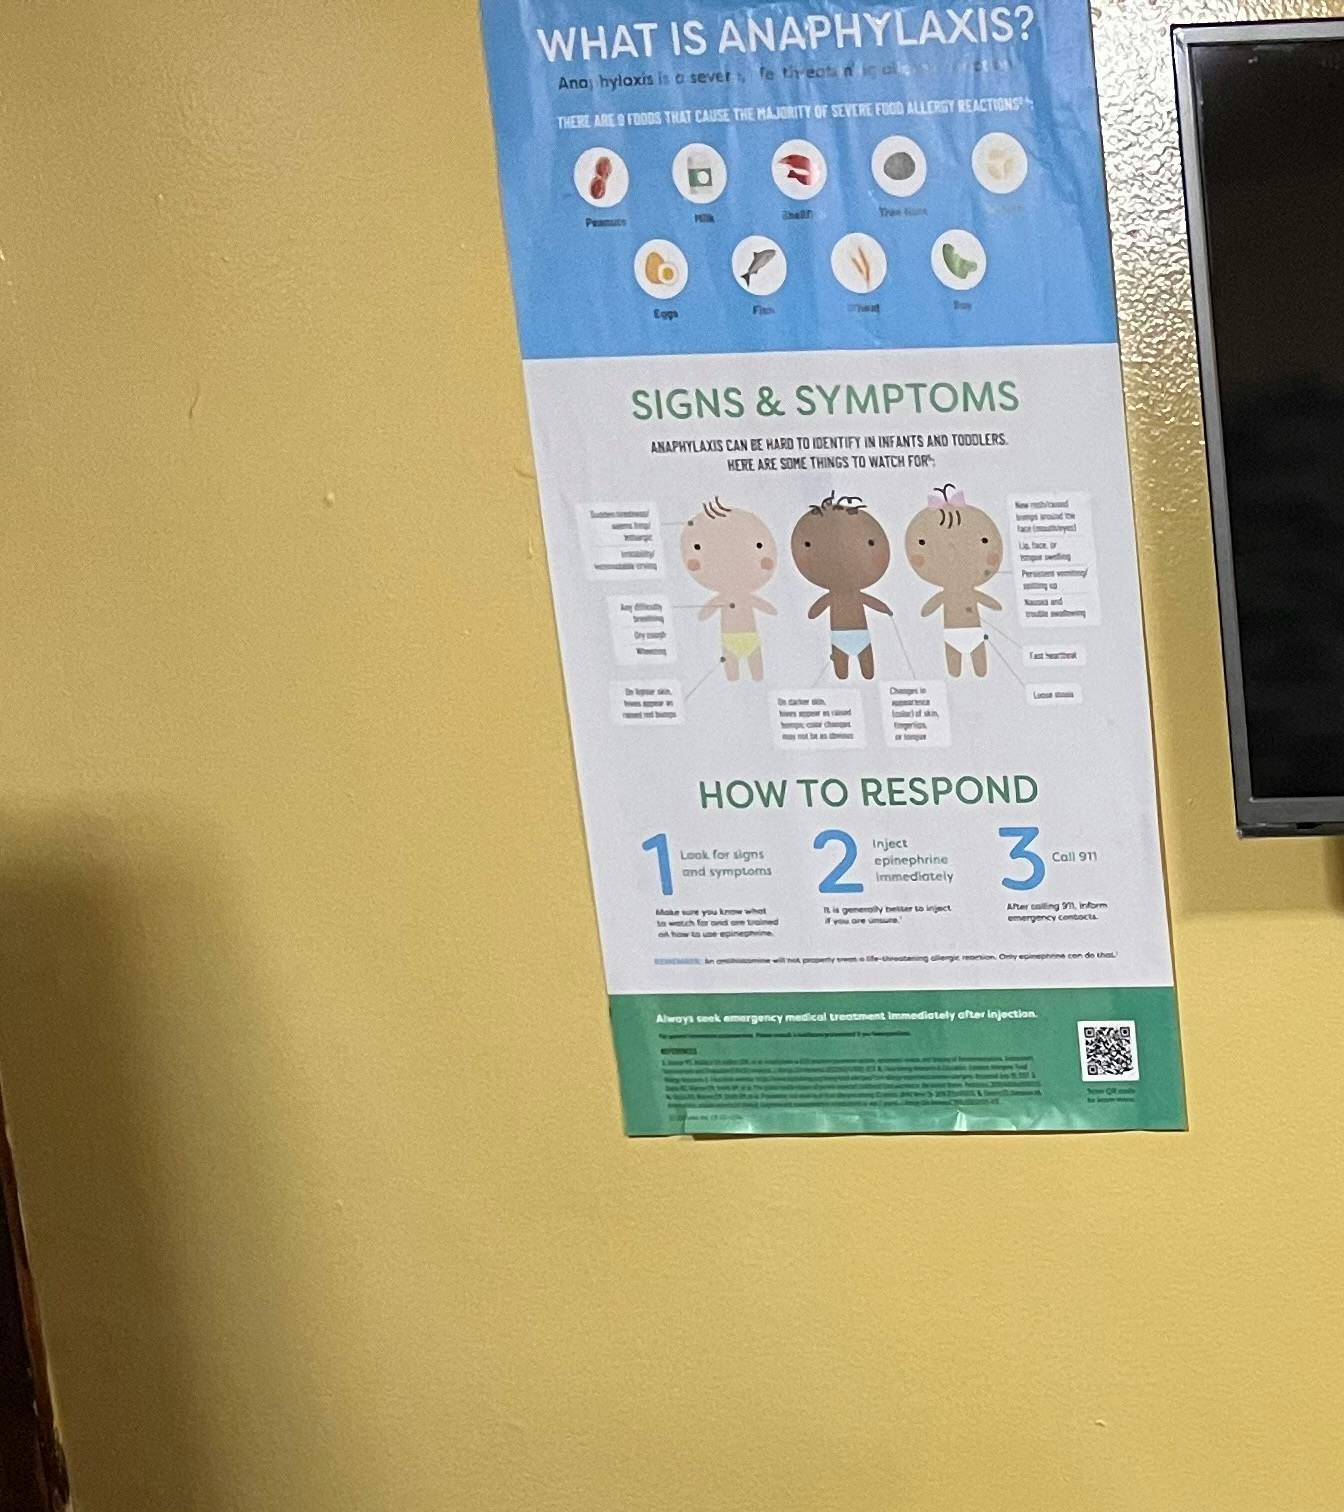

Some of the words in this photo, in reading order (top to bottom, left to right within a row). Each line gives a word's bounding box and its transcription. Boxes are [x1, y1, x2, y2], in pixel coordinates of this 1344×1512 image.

[536, 23, 658, 62] WHAT
[671, 20, 707, 56] IS
[718, 5, 1034, 54] ANAPHYLAXIS?
[558, 115, 591, 129] THERE
[594, 114, 617, 128] ARE
[627, 111, 661, 126] FOODS
[664, 109, 691, 124] THAT
[695, 108, 731, 123] CAUSE
[733, 107, 755, 122] THE
[757, 104, 812, 121] MAJORITY
[815, 104, 828, 119] OF
[831, 102, 874, 118] SEVERE
[875, 101, 904, 116] FOOD
[906, 99, 954, 115] ALLERGY
[653, 307, 679, 320] Eggs
[632, 386, 745, 420] SIGNS
[756, 385, 786, 417] &
[795, 380, 1020, 416] SYMPTOMS
[651, 439, 723, 454] ANAPHYLAXIS
[726, 438, 748, 452] CAN
[750, 438, 764, 451] BE
[766, 437, 794, 450] HARD
[797, 436, 810, 449] TO
[812, 436, 861, 450] IDENTIFY
[864, 435, 876, 448] IN
[878, 434, 924, 448] INFANTS
[927, 433, 949, 447] AND
[951, 432, 1009, 447] TODDLERS.
[727, 458, 754, 471] HERE
[757, 457, 778, 471] ARE
[780, 456, 807, 470] SOME
[810, 455, 849, 469] THINGS
[852, 455, 866, 469] TO
[868, 455, 905, 468] WATCH
[699, 779, 787, 808] HOW
[796, 778, 848, 807] TO
[860, 774, 1038, 806] RESPOND
[872, 838, 908, 851] Inject
[680, 849, 709, 860] Look
[713, 849, 729, 860] for
[733, 849, 764, 862] signs
[813, 829, 864, 893] 2
[874, 853, 948, 867] epinephrine
[998, 826, 1046, 891] 3
[1051, 851, 1076, 862] Call
[1078, 851, 1098, 862] 911
[641, 832, 673, 896] 1
[682, 866, 706, 877] and
[710, 866, 772, 879] symptoms
[702, 909, 718, 917] you
[915, 904, 924, 912] to
[926, 904, 952, 914] inject
[656, 1014, 694, 1025] Always
[696, 1013, 721, 1023] seek
[723, 1014, 783, 1025] emergency
[785, 1011, 827, 1022] medical
[829, 1011, 885, 1022] treatment
[888, 1009, 956, 1021] immediately
[957, 1009, 985, 1019] after
[987, 1008, 1038, 1021] injection.
